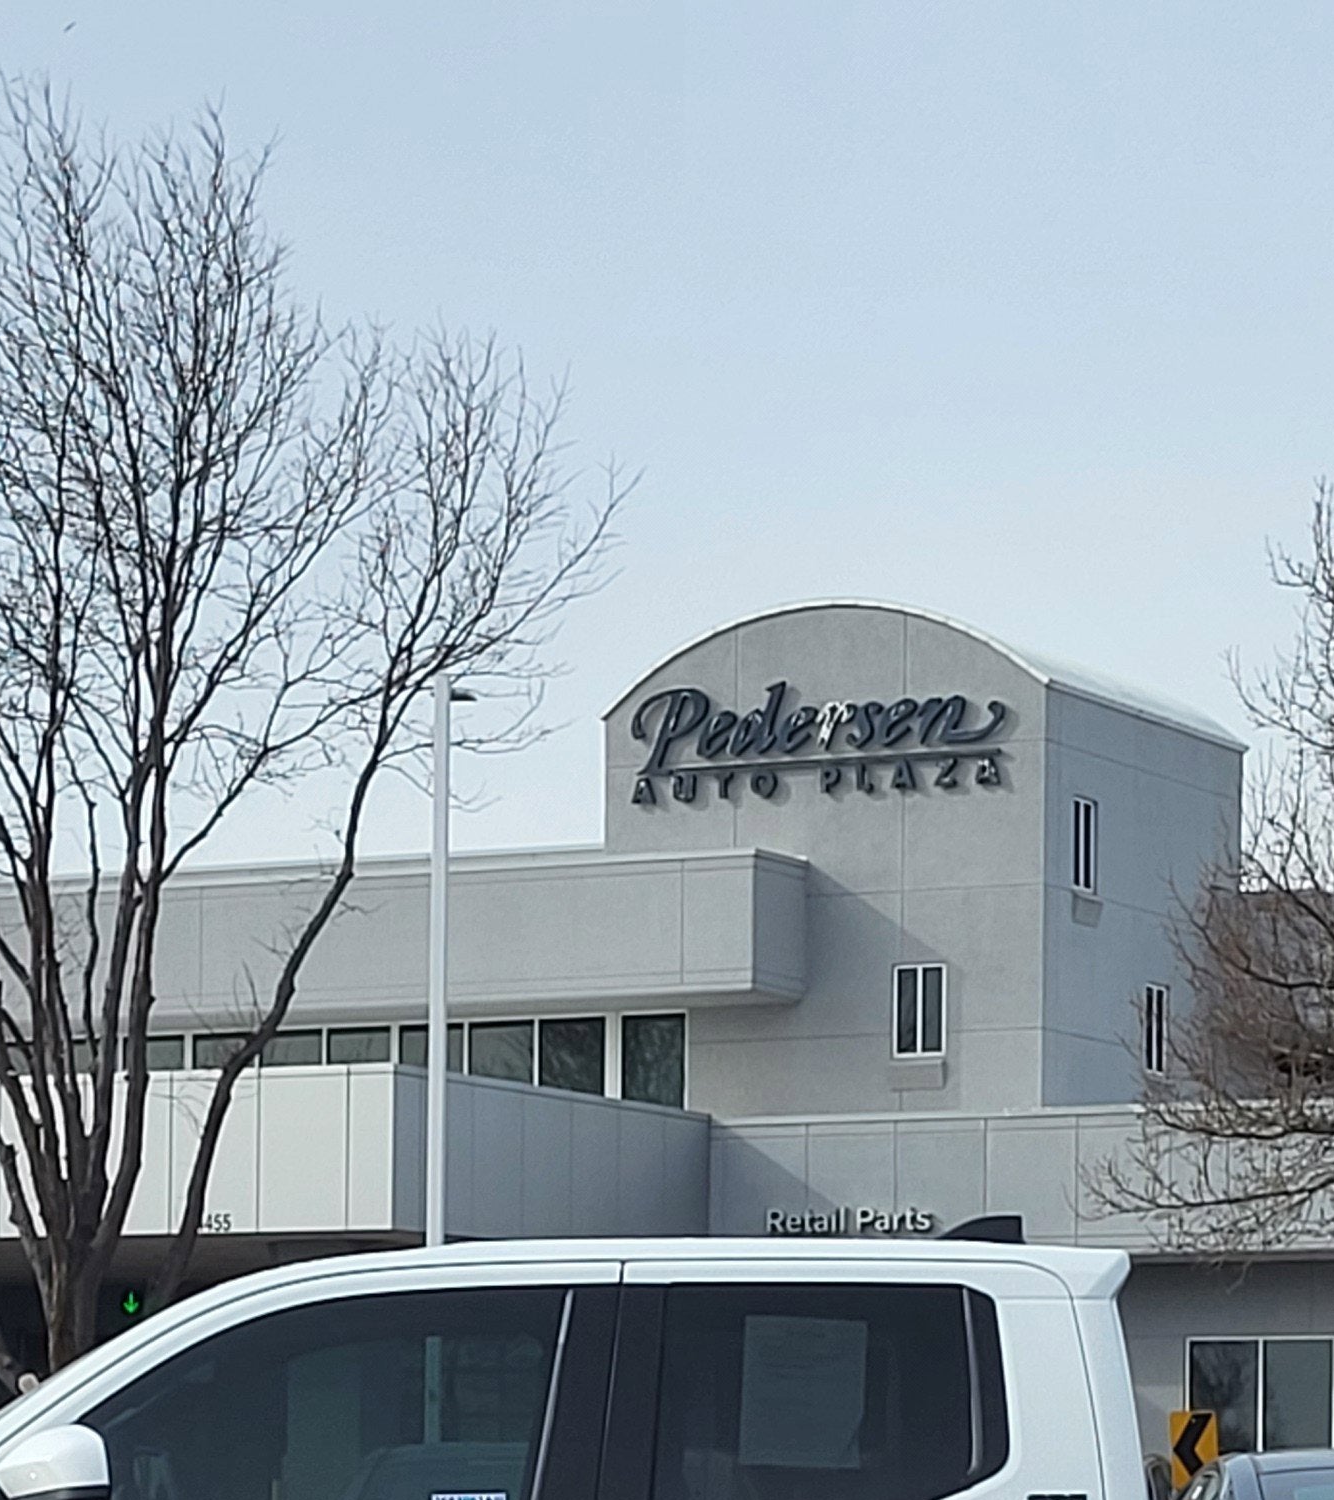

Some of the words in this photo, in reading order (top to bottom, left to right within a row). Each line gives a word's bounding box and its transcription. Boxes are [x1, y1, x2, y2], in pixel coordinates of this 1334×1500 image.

[631, 681, 1007, 775] Pedersen
[631, 770, 779, 804] AUTO
[820, 757, 1002, 795] PLAZA
[202, 1213, 232, 1232] 455
[767, 1206, 845, 1234] Retail
[855, 1206, 933, 1232] Parts
